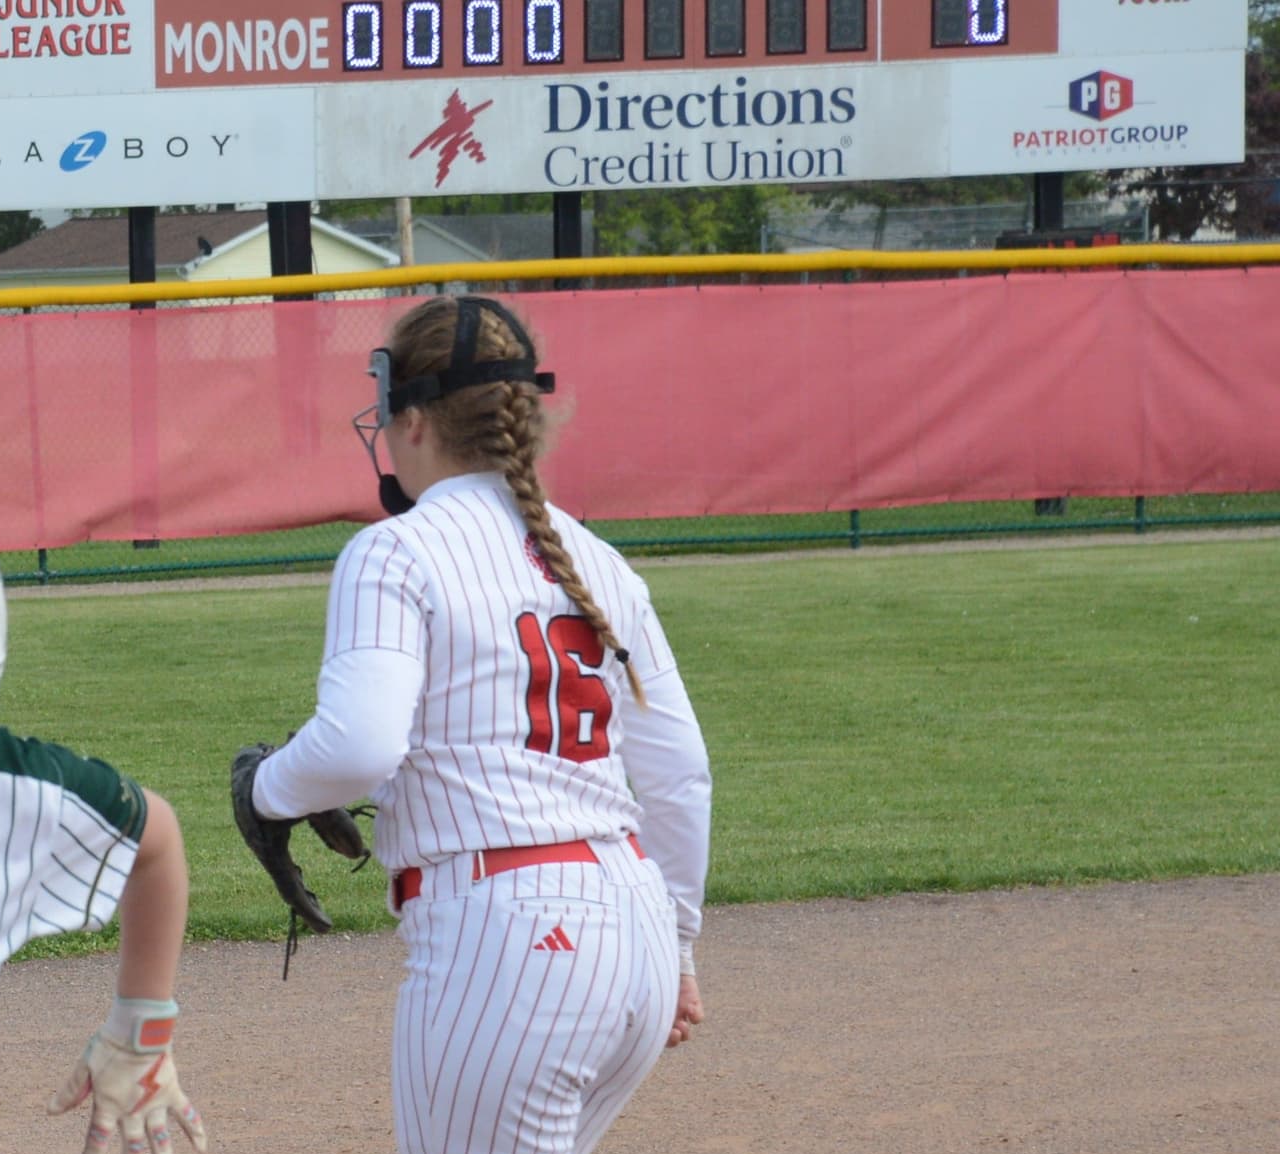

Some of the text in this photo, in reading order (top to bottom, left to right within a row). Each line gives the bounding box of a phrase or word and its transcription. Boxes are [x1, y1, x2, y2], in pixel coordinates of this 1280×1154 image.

[164, 17, 330, 75] MONROE
[544, 76, 856, 134] Directions
[544, 142, 689, 188] Credit
[515, 611, 612, 763] 16
